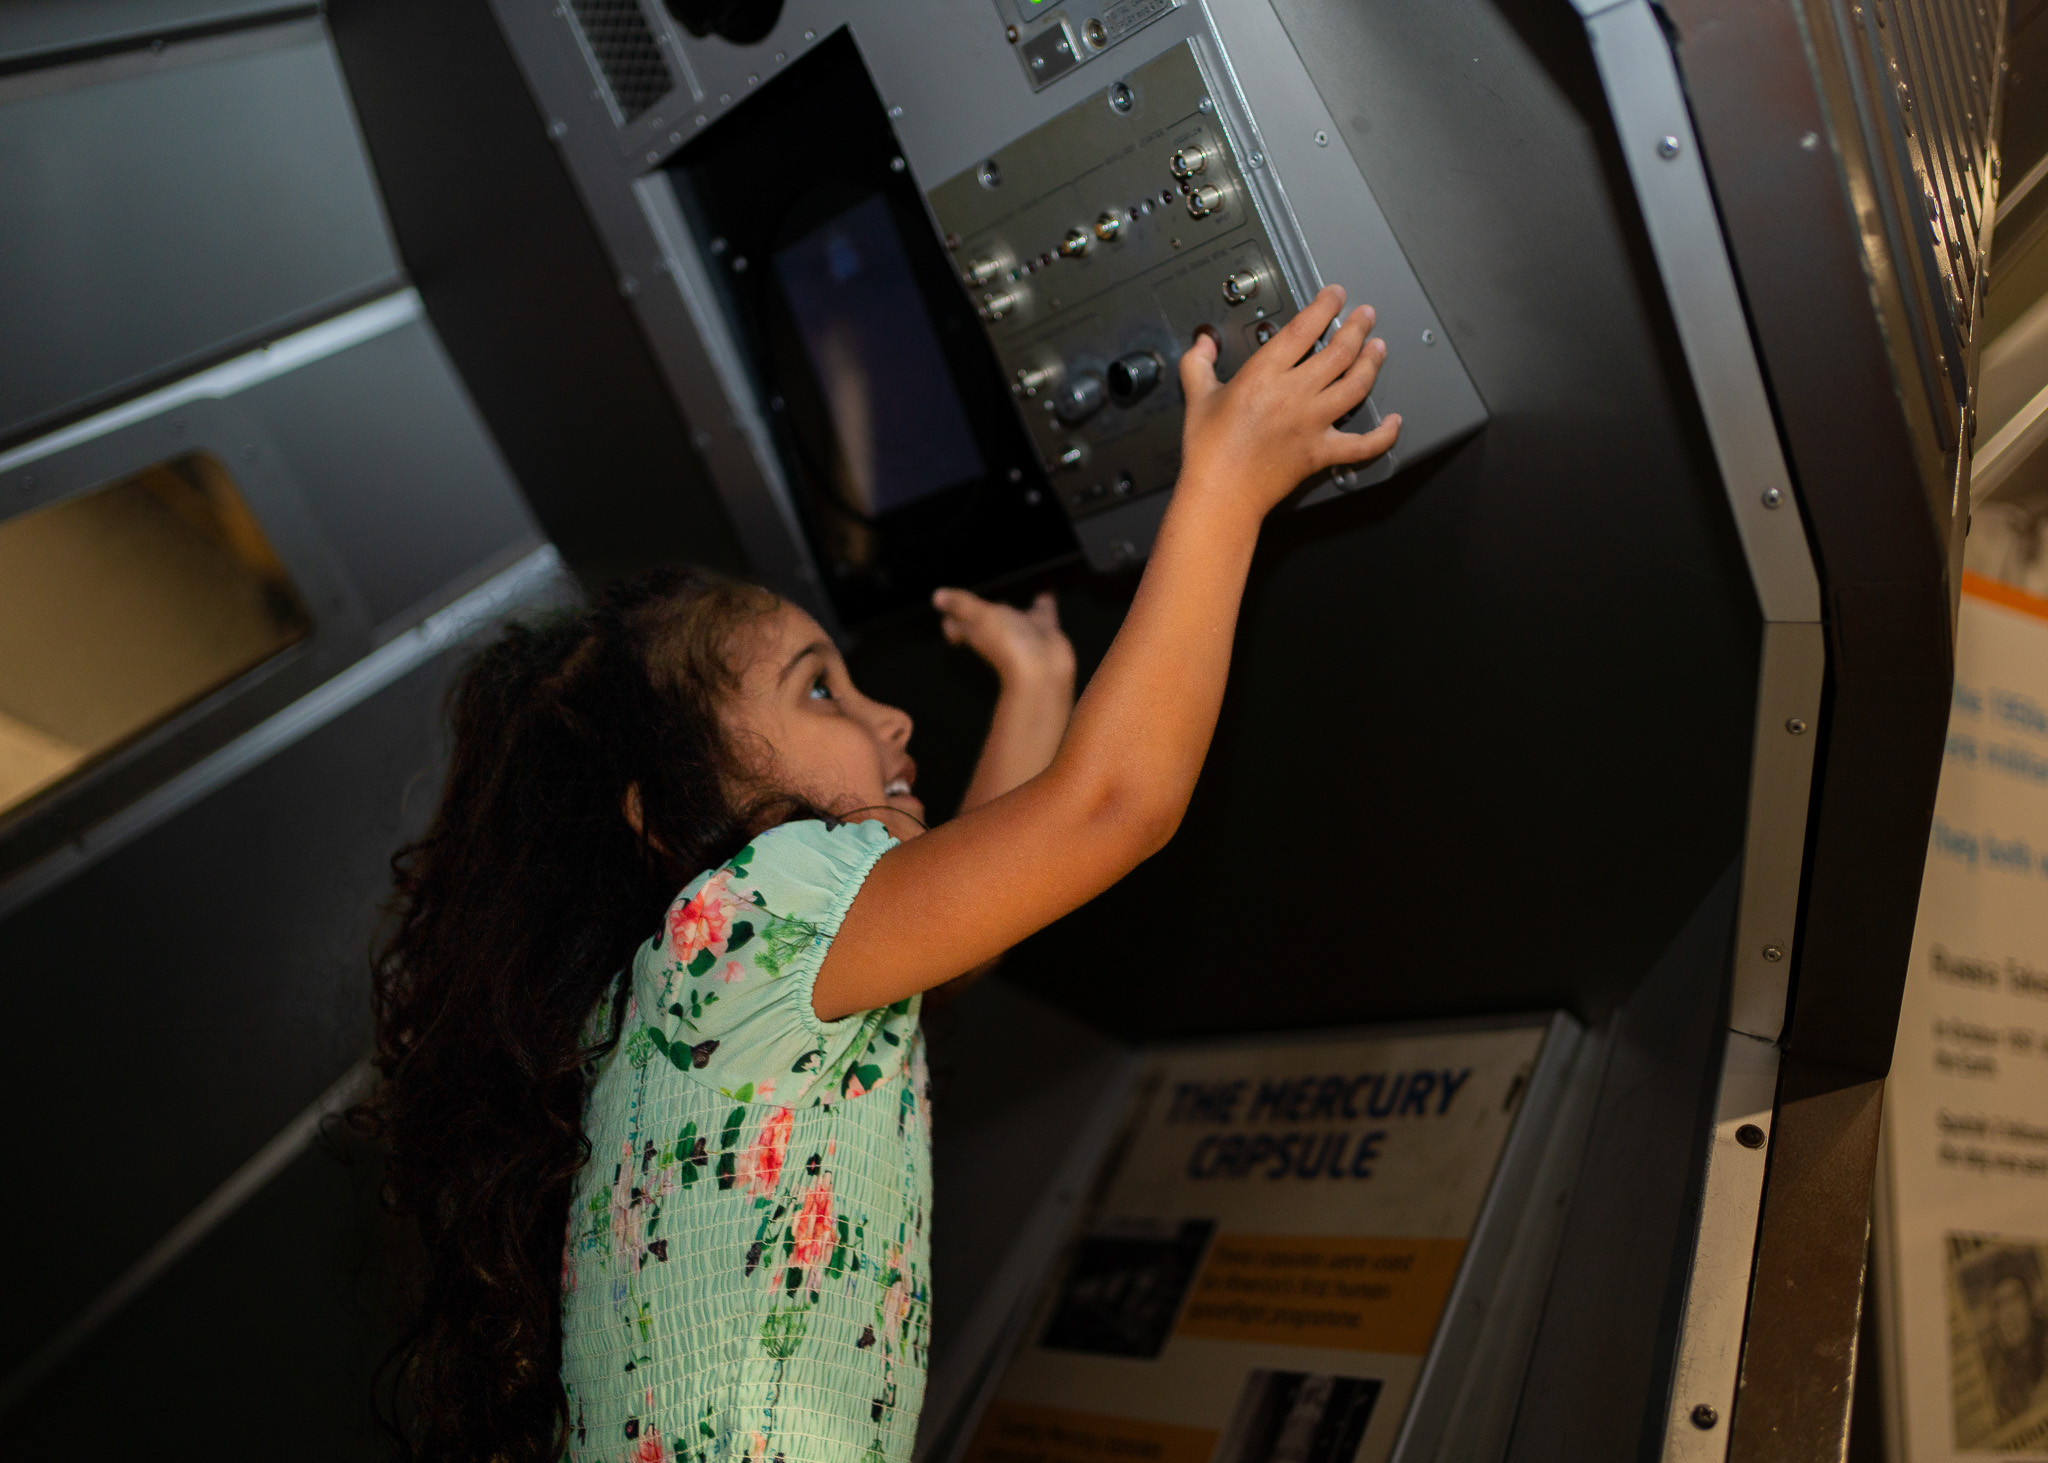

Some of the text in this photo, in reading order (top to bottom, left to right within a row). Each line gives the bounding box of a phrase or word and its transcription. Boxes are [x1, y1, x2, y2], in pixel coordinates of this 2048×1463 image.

[1167, 1069, 1471, 1123] THE MERCURY
[1190, 1131, 1385, 1178] CAPSULE
